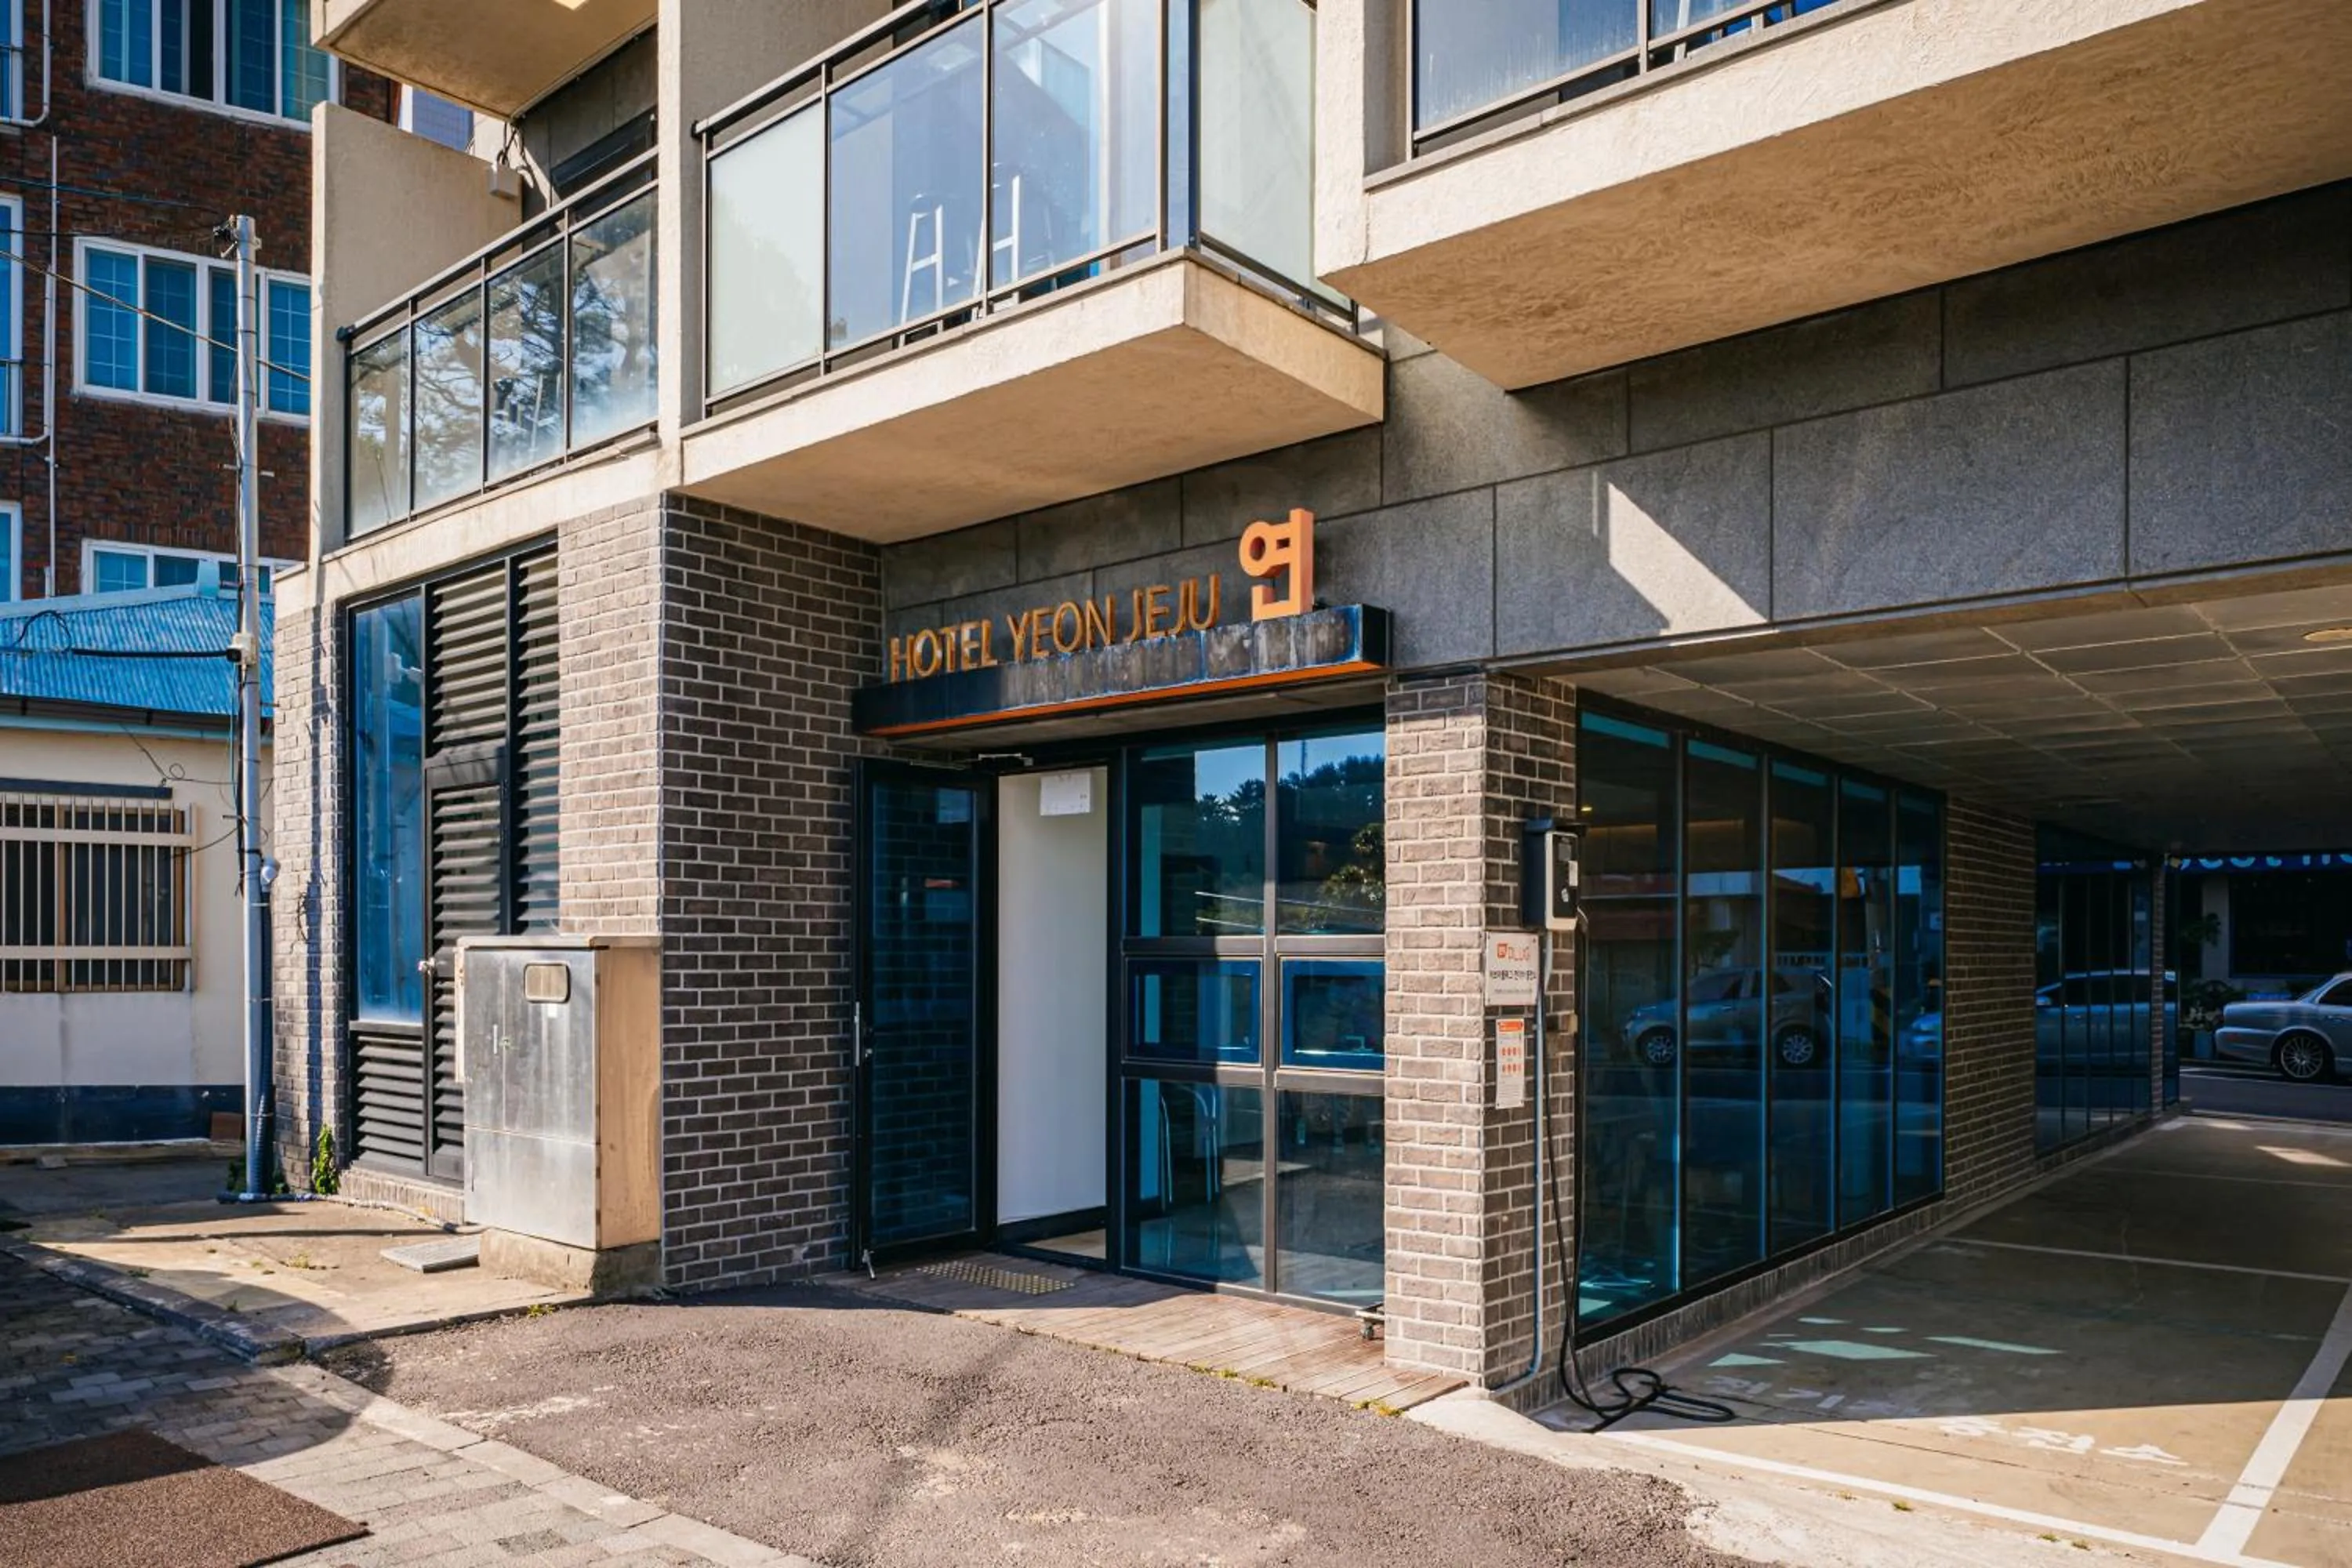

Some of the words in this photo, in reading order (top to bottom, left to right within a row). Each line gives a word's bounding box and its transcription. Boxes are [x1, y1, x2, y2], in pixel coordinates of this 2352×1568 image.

[1239, 508, 1314, 622] 연
[891, 619, 998, 682] HOTEL
[1007, 594, 1115, 662] YEON
[1128, 575, 1220, 641] JEJU
[1936, 1416, 2189, 1465] 충전소
